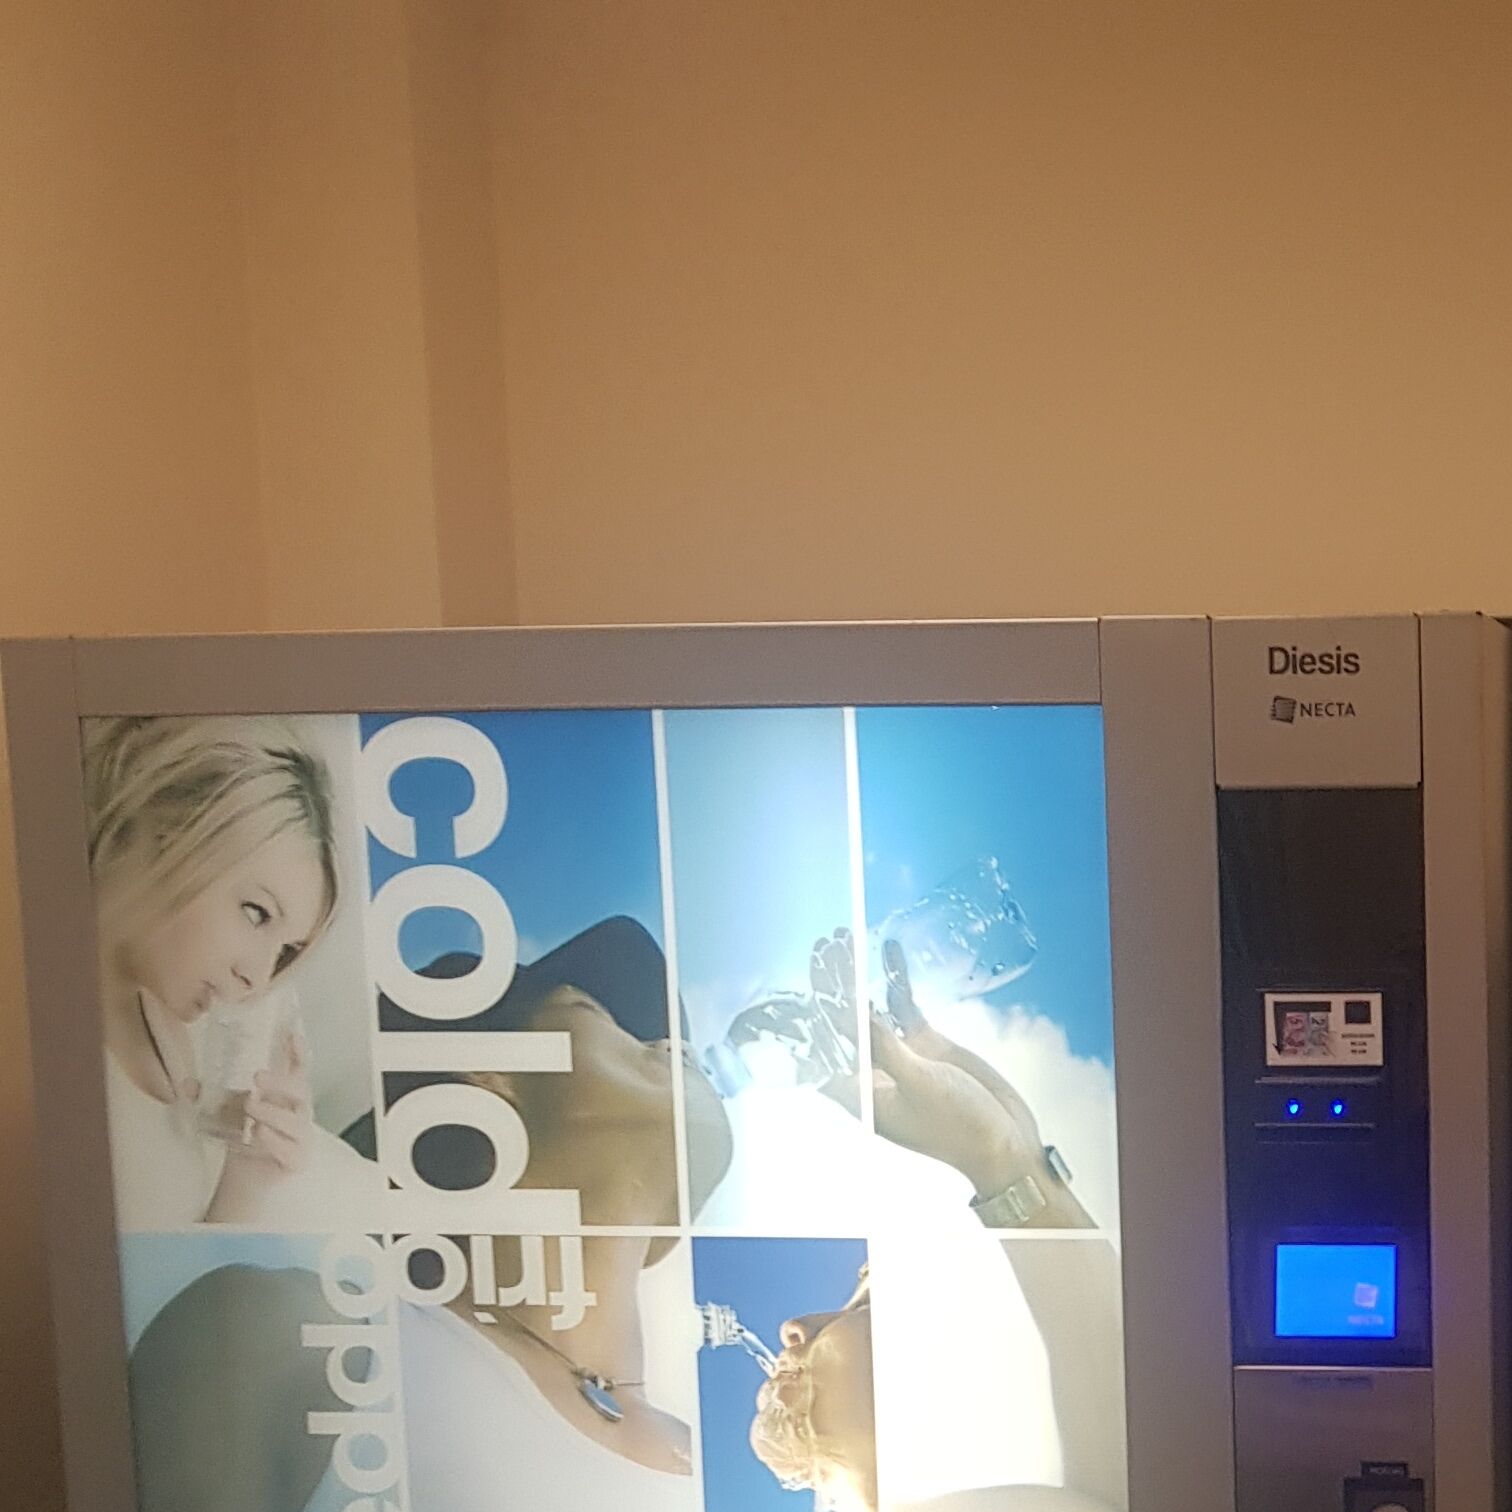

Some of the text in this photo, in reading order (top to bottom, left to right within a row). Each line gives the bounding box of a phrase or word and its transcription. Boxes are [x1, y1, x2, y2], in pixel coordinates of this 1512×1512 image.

[1267, 644, 1361, 675] Diesis
[1299, 702, 1357, 718] NECTA
[361, 715, 581, 1227] cold
